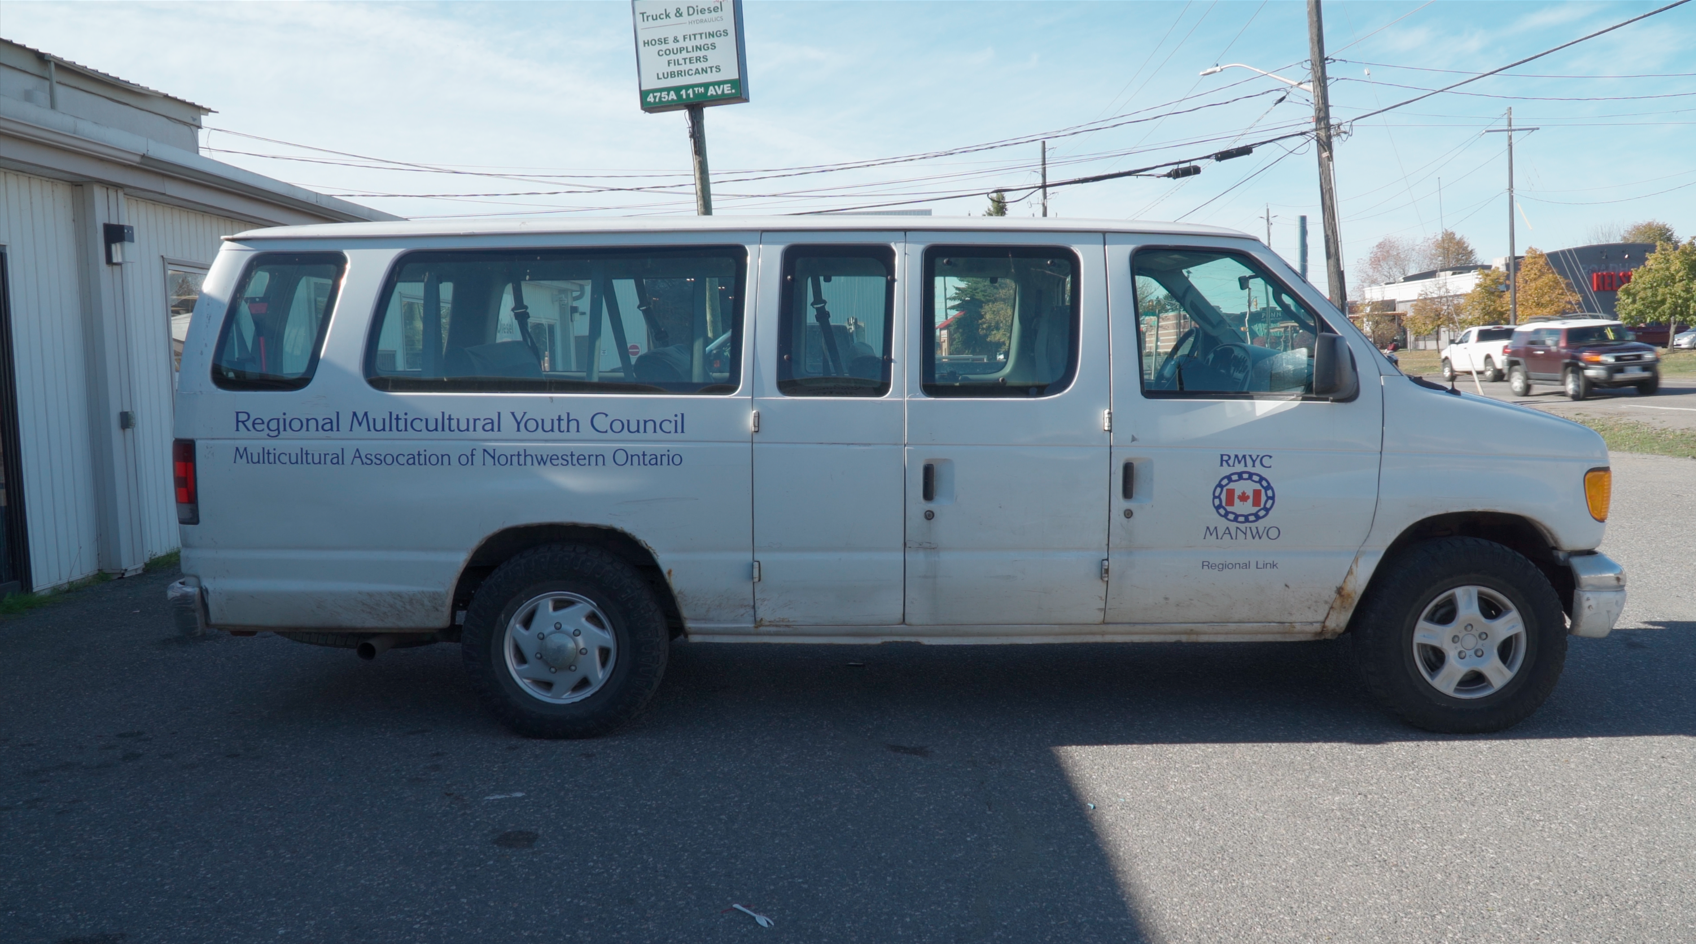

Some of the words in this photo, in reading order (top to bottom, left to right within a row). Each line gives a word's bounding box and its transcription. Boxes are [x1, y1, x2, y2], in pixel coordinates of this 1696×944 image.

[639, 8, 671, 22] Truck
[674, 7, 683, 18] &
[687, 1, 723, 16] Diesel
[688, 16, 723, 25] HYDRAULICS
[643, 36, 669, 47] HOSE
[672, 36, 680, 44] &
[683, 29, 729, 42] FITTINGS
[657, 42, 717, 57] COUPLINGS
[667, 55, 708, 67] FILTERS
[657, 65, 721, 80] LUBRICANTS
[646, 90, 677, 103] 475A
[680, 87, 704, 99] 11TH
[708, 84, 735, 96] AVE.
[234, 411, 340, 438] Regional
[349, 411, 502, 432] Multicultural
[510, 412, 580, 433] Youth
[590, 412, 686, 434] Council
[234, 447, 345, 465] Multicultural
[350, 448, 451, 466] Assocation
[458, 448, 476, 466] of
[482, 448, 606, 466] Northwestern
[612, 448, 683, 466] Ontario
[1219, 454, 1273, 468] RMYC
[1203, 526, 1281, 540] MANWO
[1202, 560, 1250, 572] Regional
[1256, 560, 1278, 570] Link
